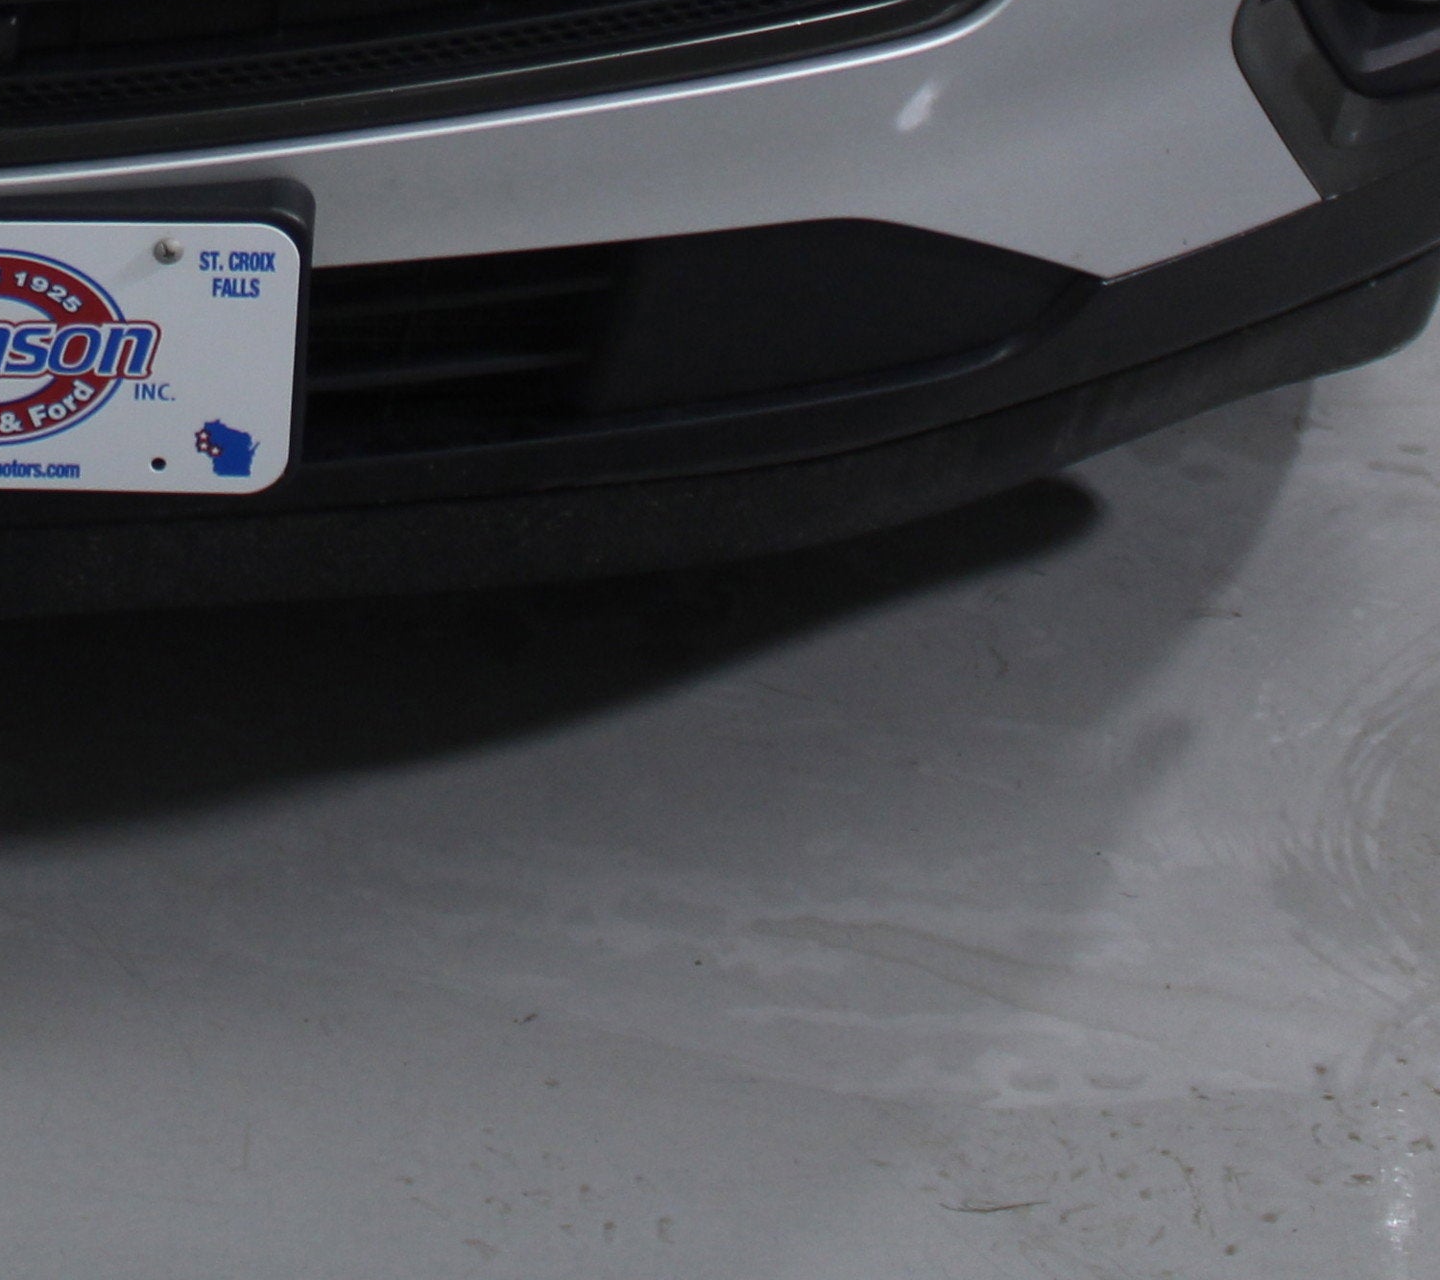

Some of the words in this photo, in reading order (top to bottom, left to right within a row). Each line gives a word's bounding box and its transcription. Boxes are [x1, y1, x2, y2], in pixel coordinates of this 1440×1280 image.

[199, 251, 224, 271] ST.
[228, 252, 277, 272] CROIX
[14, 270, 84, 314] 1925
[212, 277, 261, 298] FALLS
[134, 383, 176, 401] INC.
[0, 411, 23, 434] &
[27, 378, 96, 428] Ford
